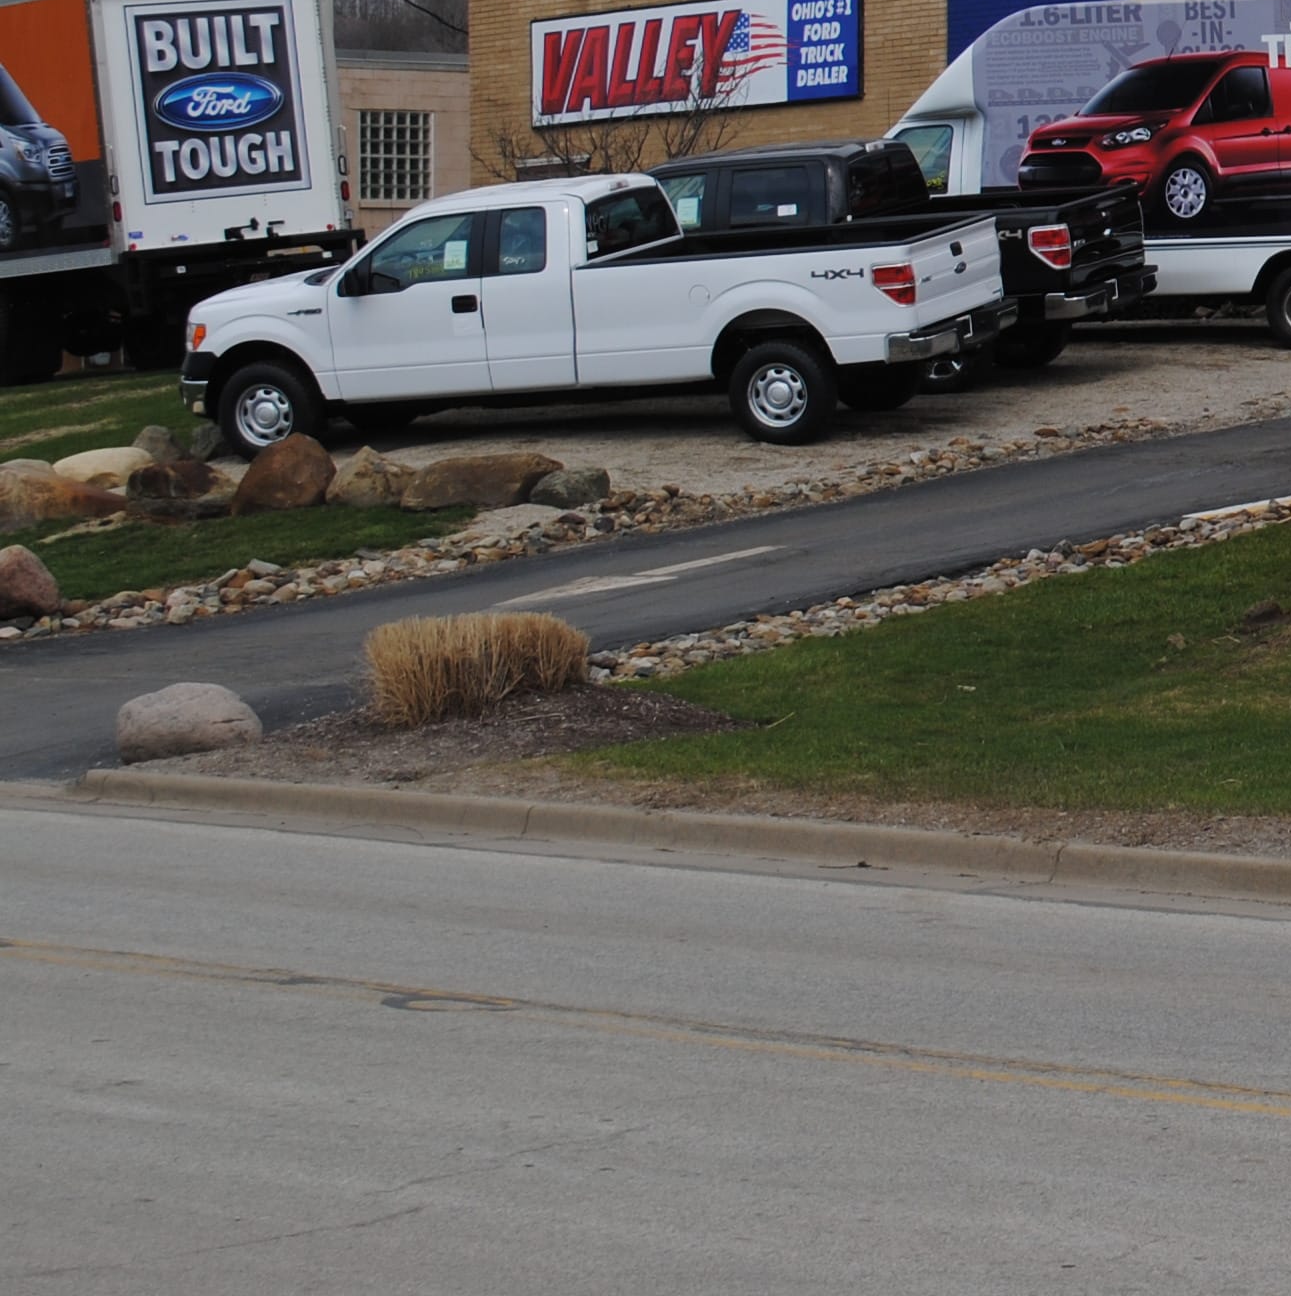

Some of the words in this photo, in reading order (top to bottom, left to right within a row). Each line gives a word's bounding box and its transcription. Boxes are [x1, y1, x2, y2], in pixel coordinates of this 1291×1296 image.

[791, 0, 834, 22] OHIO'S
[1184, 0, 1236, 21] BEST
[142, 12, 279, 72] BUILT
[803, 21, 840, 42] FORD
[991, 29, 1074, 46] ECOBOOST
[1079, 25, 1138, 43] ENGINE
[541, 9, 742, 115] VALLEY
[800, 43, 844, 66] TRUCK
[796, 65, 848, 87] DEALER
[186, 86, 251, 117] Ford
[153, 131, 293, 182] TOUGH
